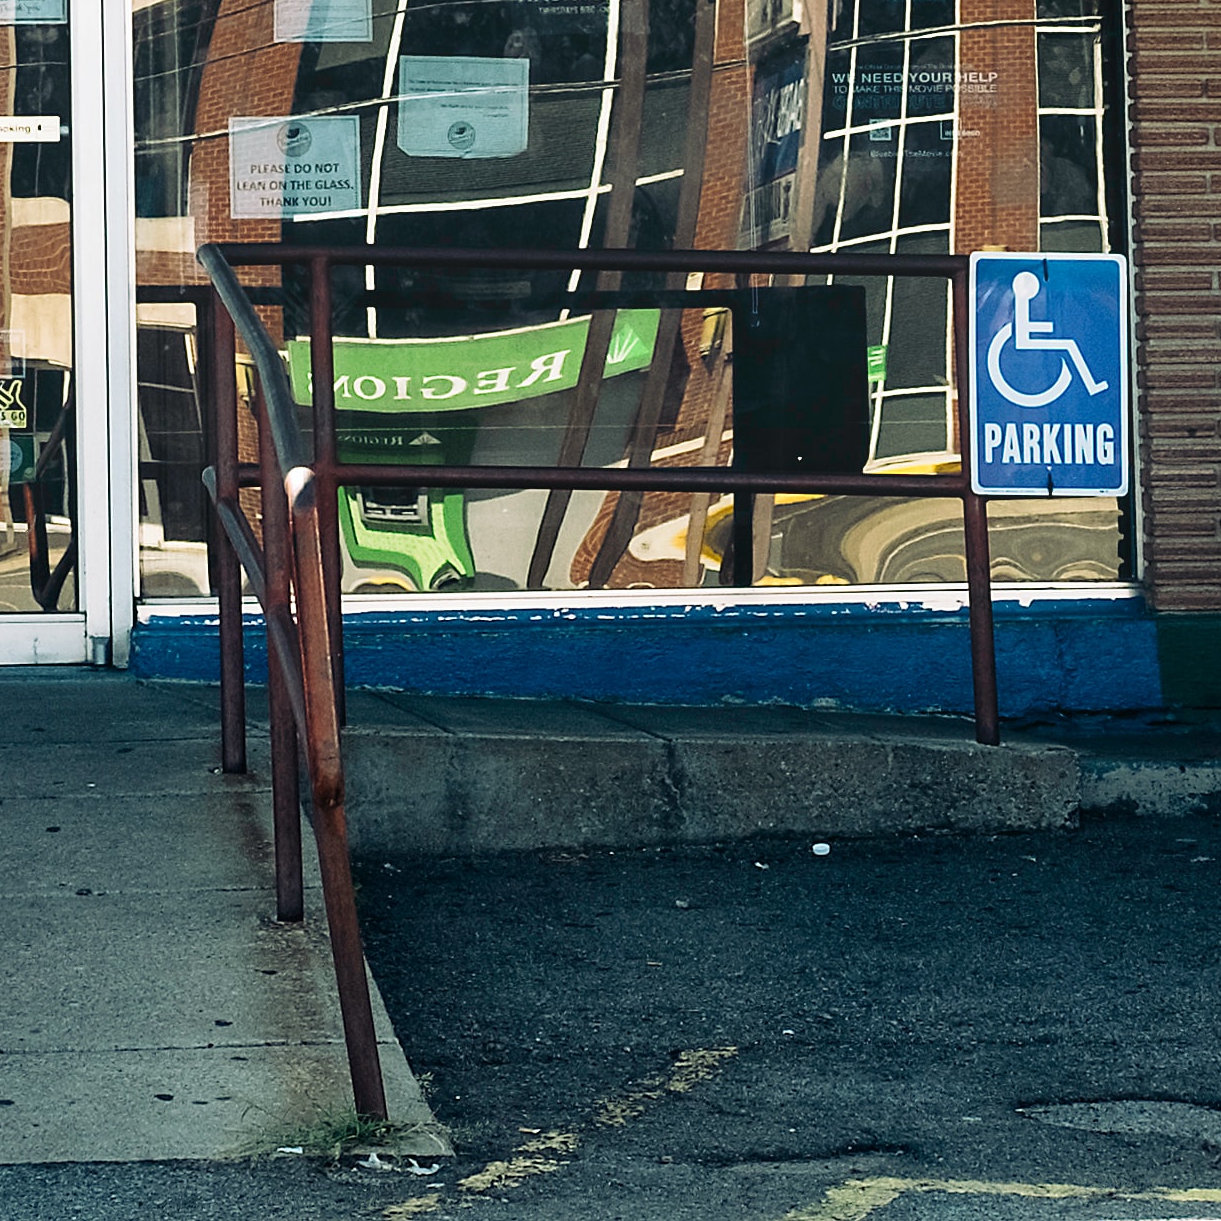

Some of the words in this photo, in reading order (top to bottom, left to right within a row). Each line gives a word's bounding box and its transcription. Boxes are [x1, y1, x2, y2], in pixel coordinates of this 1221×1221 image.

[861, 73, 903, 83] NEED
[910, 73, 952, 83] YOUR
[959, 73, 998, 83] HELP
[833, 85, 848, 94] TO
[251, 164, 290, 174] PLEASE
[294, 164, 312, 173] DO
[315, 163, 339, 173] NOT
[237, 182, 266, 191] LEAN
[269, 181, 287, 191] ON
[290, 181, 313, 190] THE
[315, 180, 354, 190] GLASS.
[260, 197, 299, 207] THANK
[302, 196, 332, 206] YOU!
[11, 412, 25, 421] GO
[984, 423, 1115, 465] PARKING
